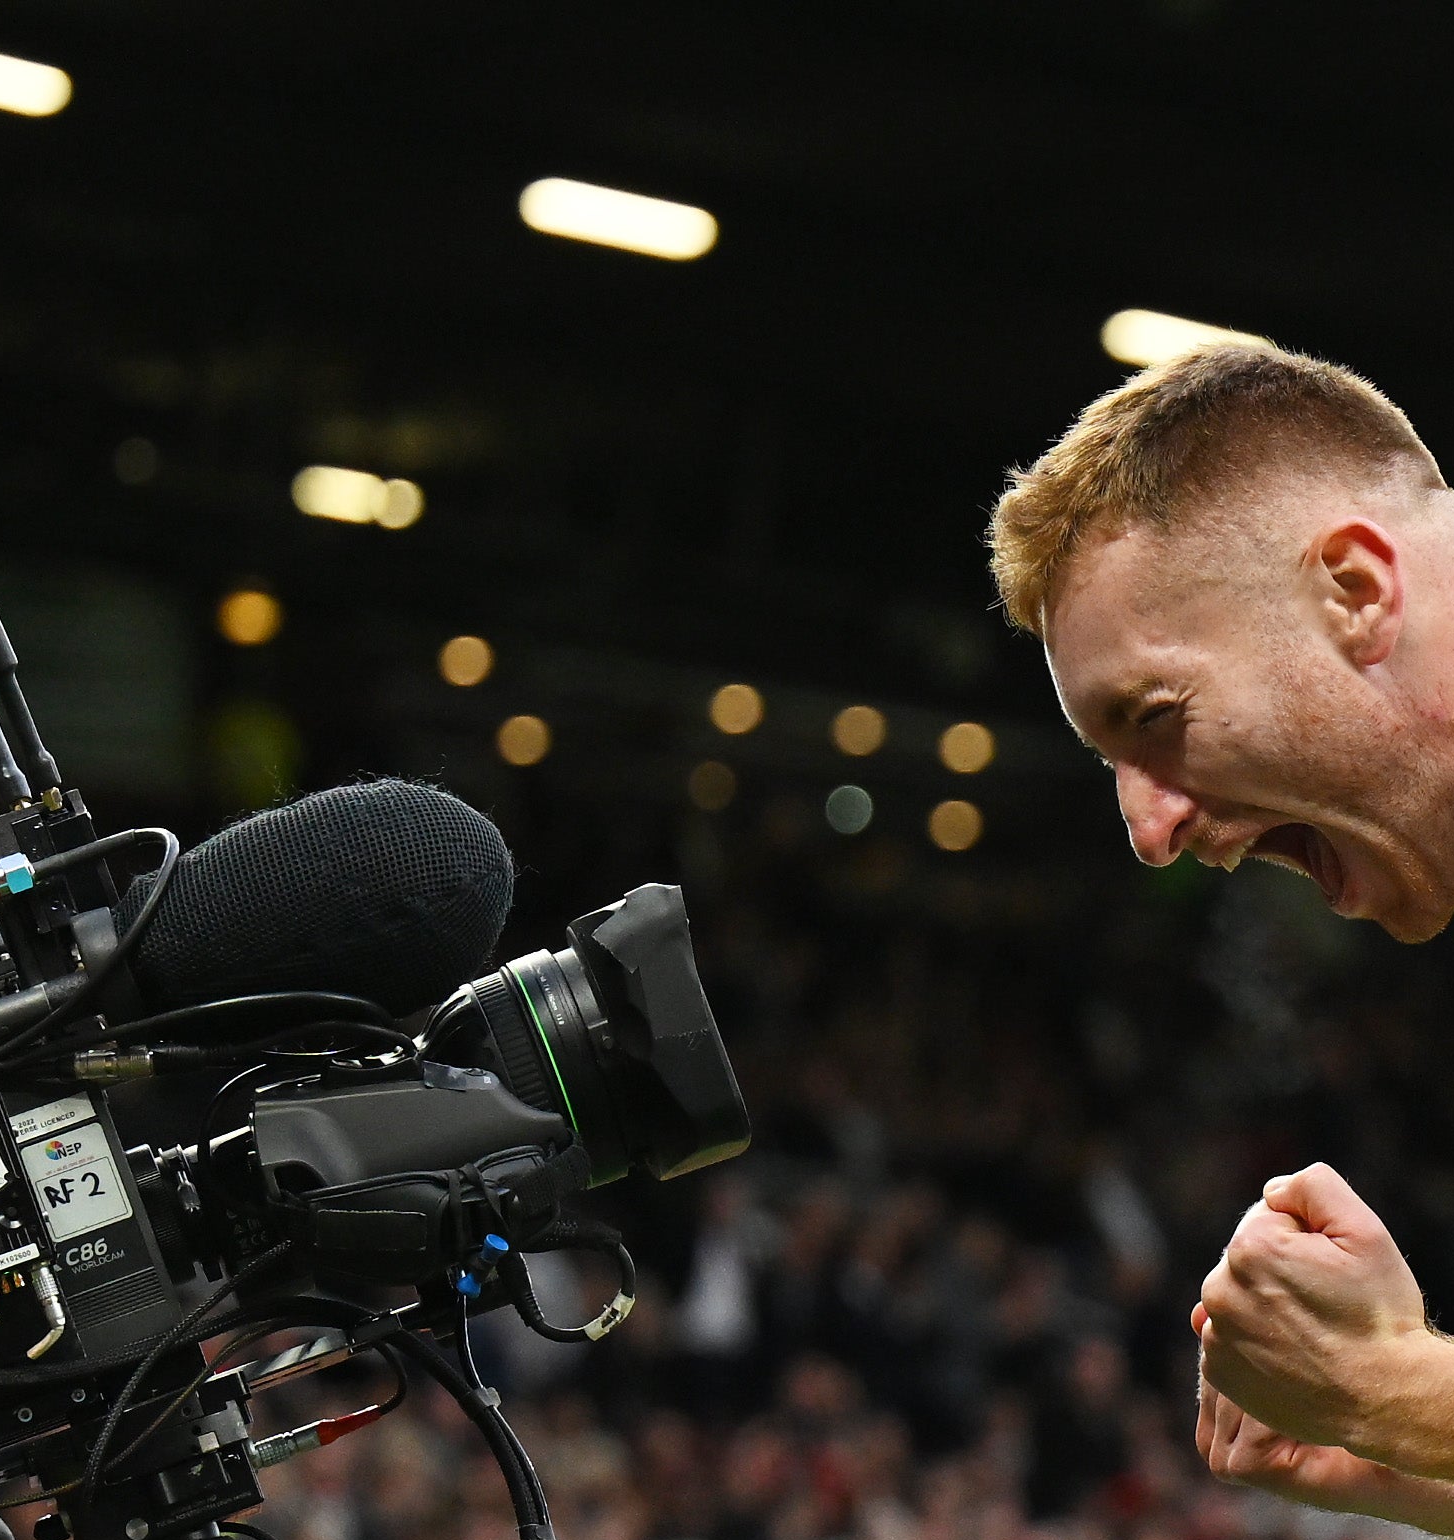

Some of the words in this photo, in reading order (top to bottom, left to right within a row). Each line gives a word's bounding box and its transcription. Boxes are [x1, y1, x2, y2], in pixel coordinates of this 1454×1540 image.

[18, 1118, 34, 1127] 2022
[40, 1111, 75, 1128] LICENCED
[57, 1142, 81, 1158] NEP
[43, 1178, 74, 1208] RF
[81, 1173, 105, 1196] 2
[66, 1238, 108, 1266] C86
[71, 1250, 125, 1274] WORLDCAM
